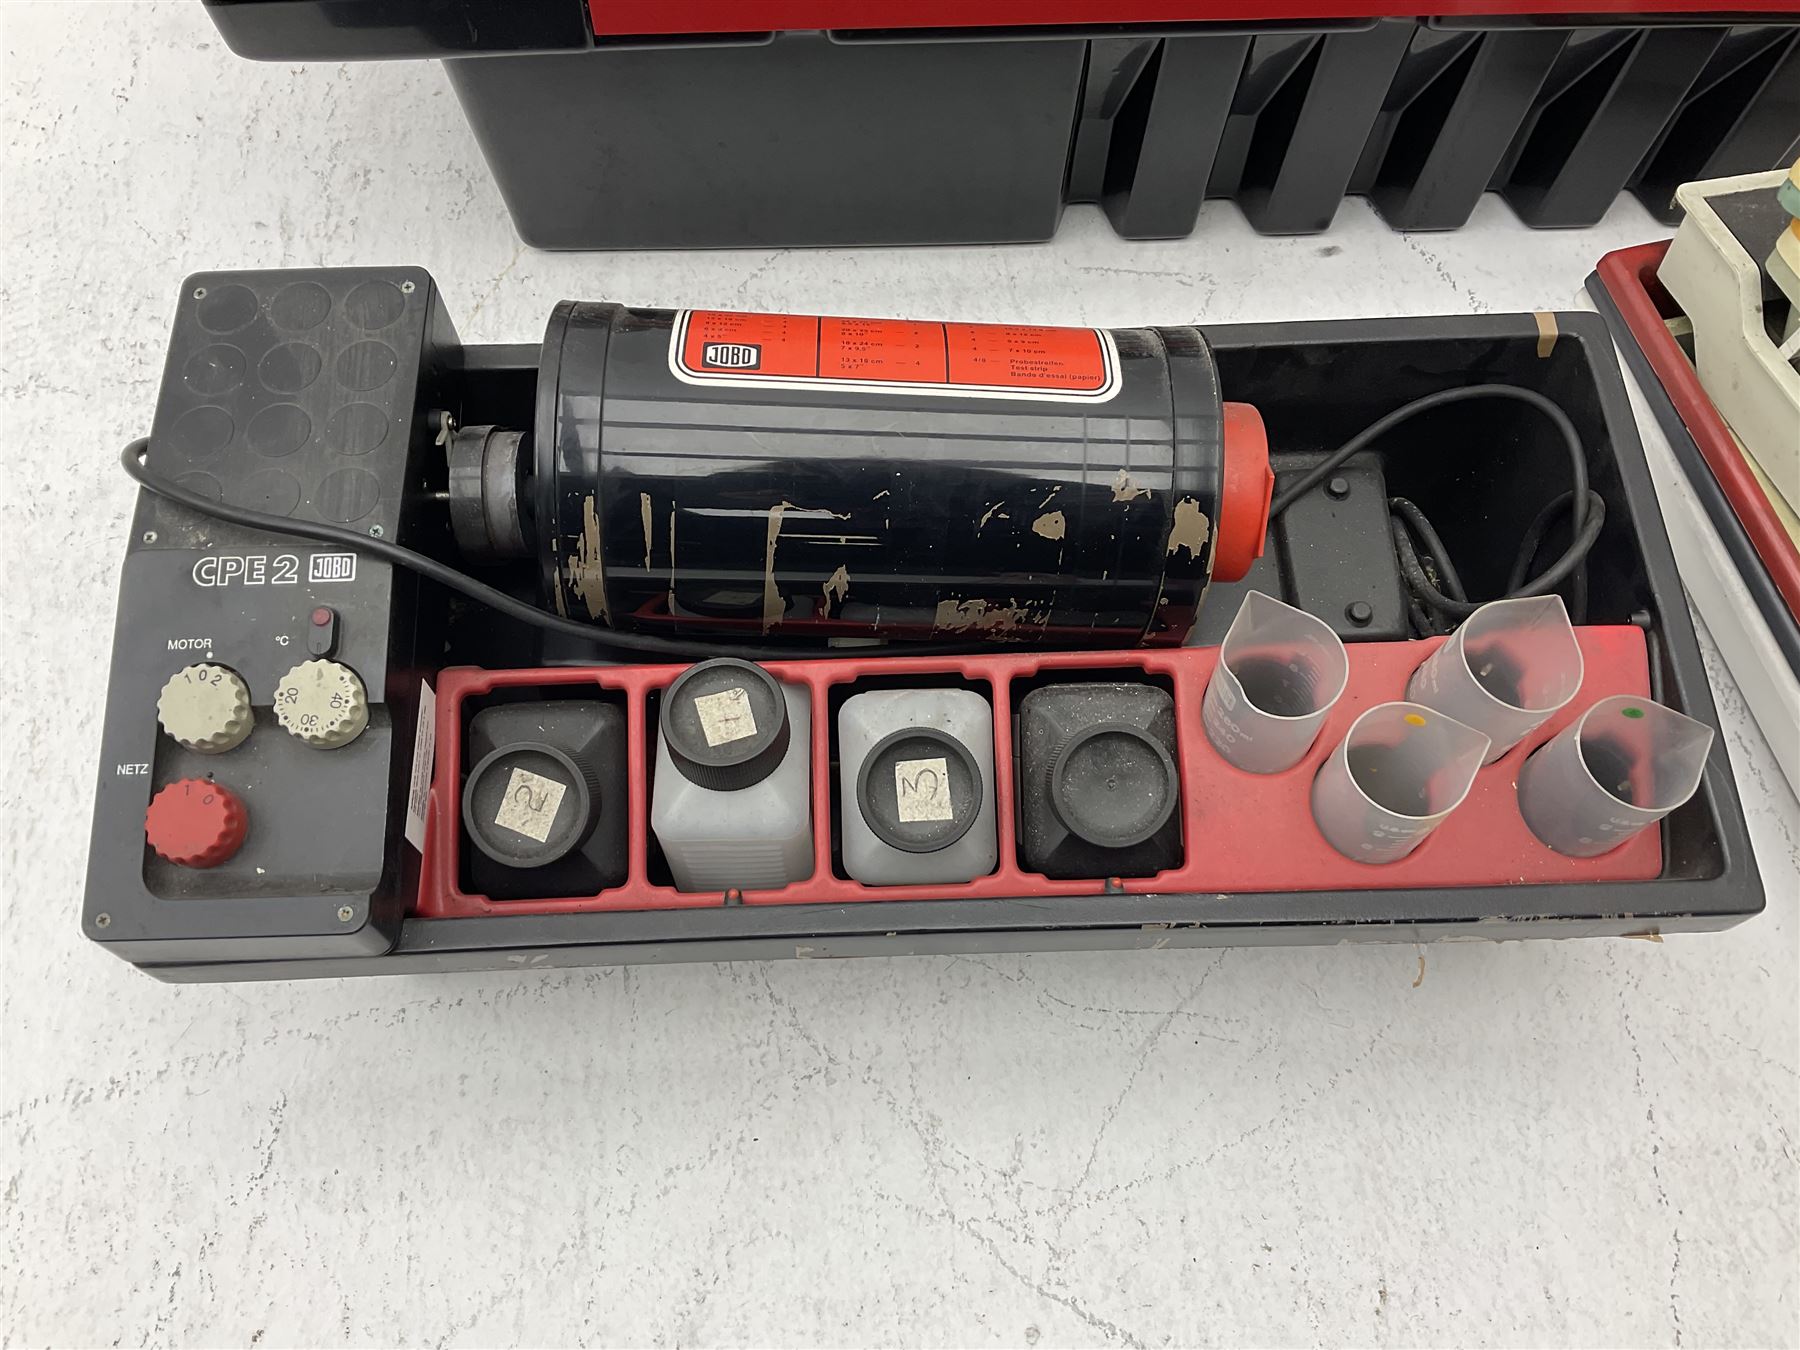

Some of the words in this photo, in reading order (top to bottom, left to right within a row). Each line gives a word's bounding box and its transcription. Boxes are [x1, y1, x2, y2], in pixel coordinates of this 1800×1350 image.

[709, 346, 751, 365] JOBO
[192, 556, 267, 586] CPE
[271, 555, 299, 584] 2
[313, 558, 352, 580] JOBO
[167, 638, 212, 650] MOTOR
[199, 670, 207, 681] 0
[210, 674, 223, 687] 2
[285, 687, 299, 705] 20
[329, 692, 342, 709] 40
[300, 714, 319, 726] 30
[116, 764, 149, 775] NETZ
